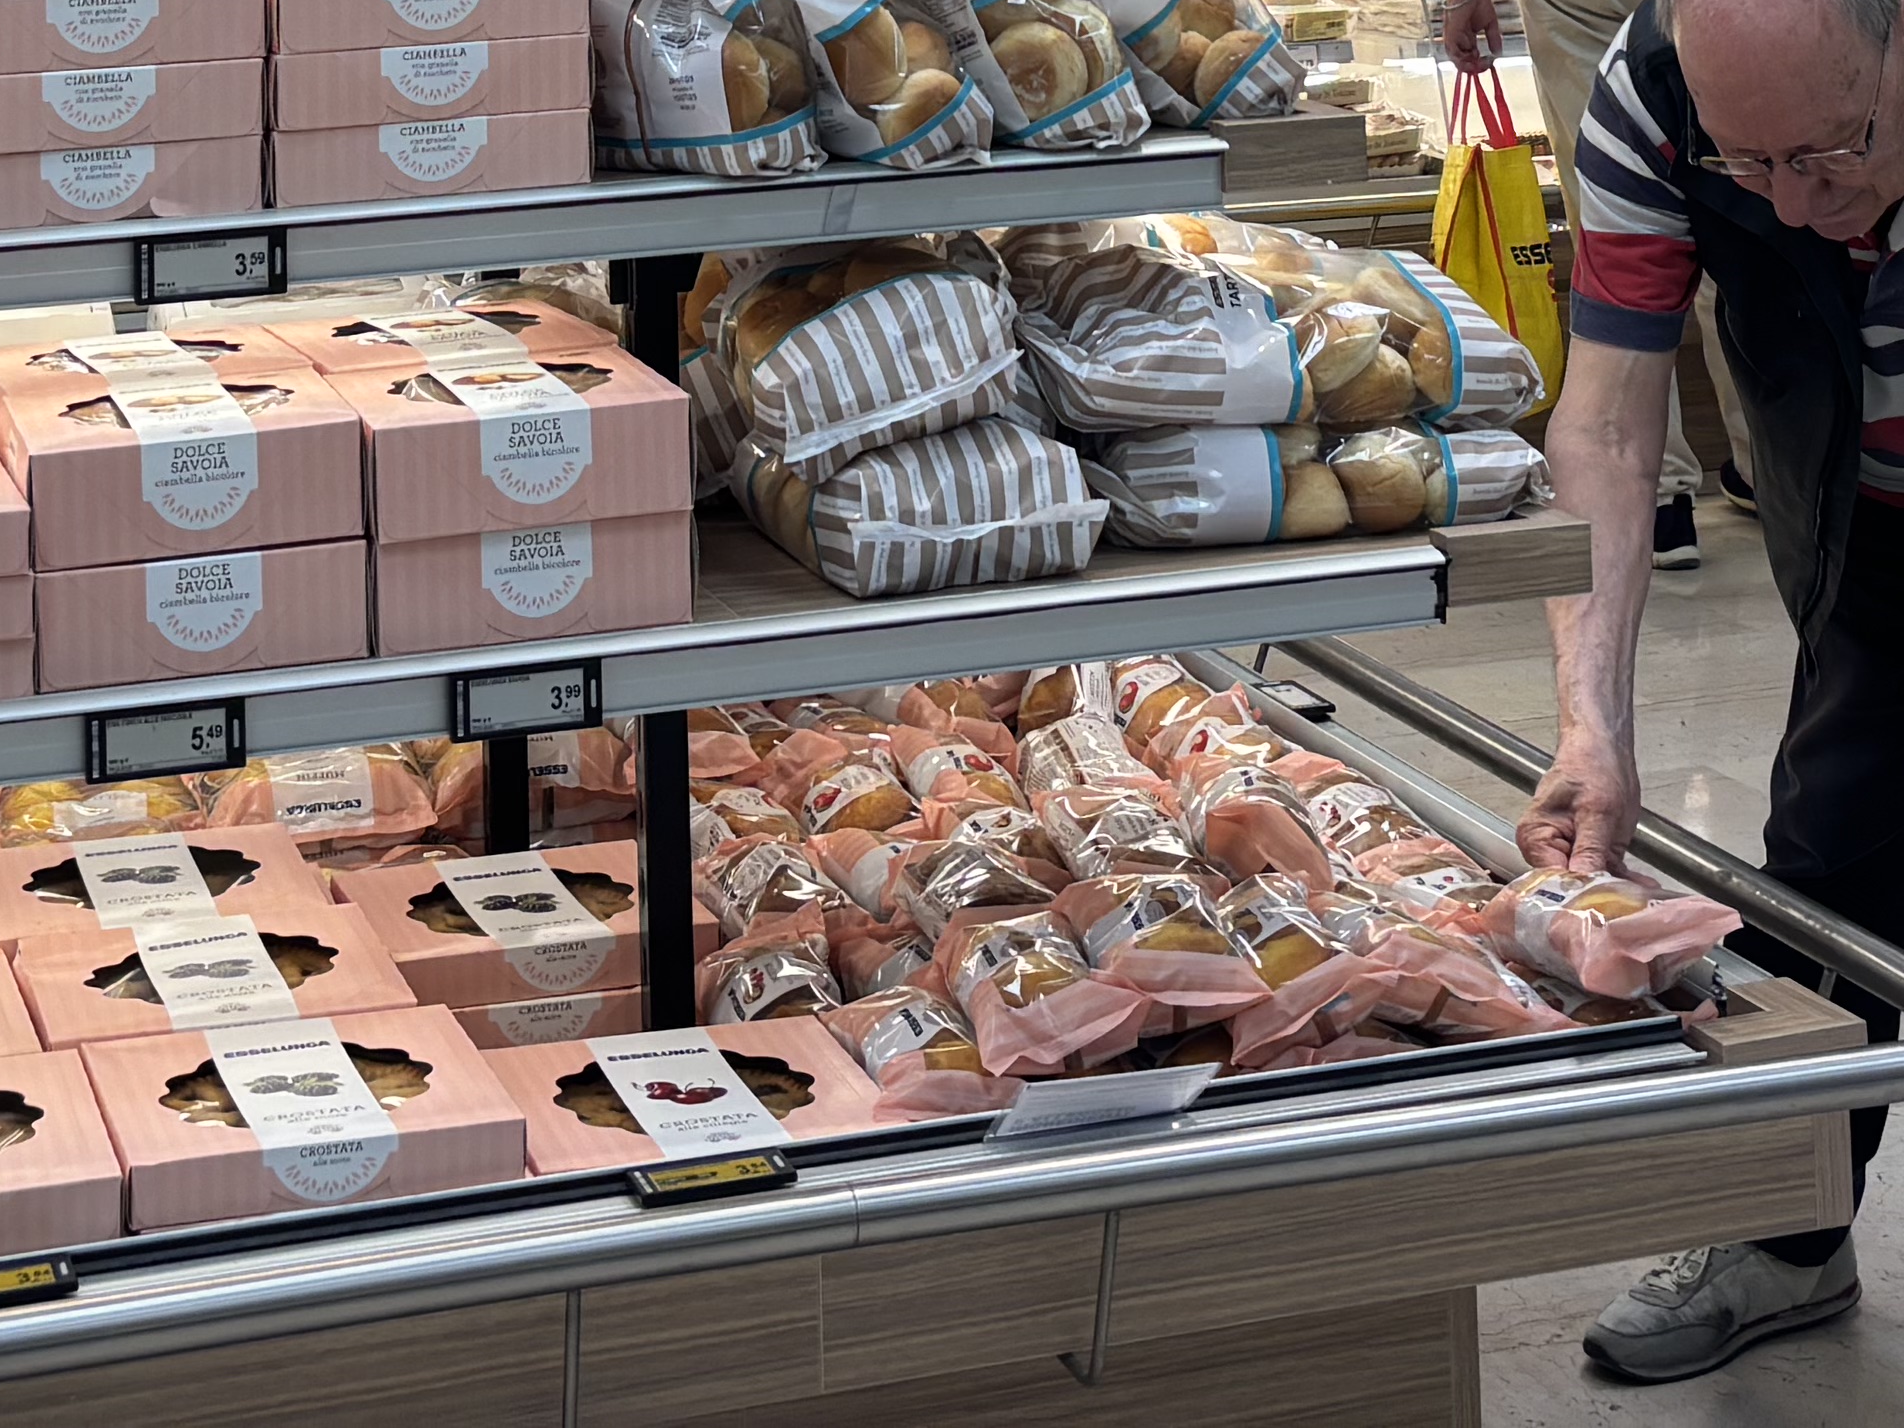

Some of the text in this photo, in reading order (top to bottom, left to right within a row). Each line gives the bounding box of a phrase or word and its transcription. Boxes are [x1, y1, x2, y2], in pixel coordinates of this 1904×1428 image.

[401, 47, 468, 62] CIAMBELLA
[63, 71, 134, 87] CIAMBELLA
[399, 122, 467, 137] CIAMBELLA
[62, 149, 132, 164] CIAMBELLA
[233, 251, 266, 275] 3,59
[510, 417, 562, 434] DOLCE
[508, 430, 565, 448] SAVOIA
[173, 442, 227, 460] DOLCE
[170, 454, 229, 474] SAVOIA
[510, 530, 562, 547] DOLCE
[508, 544, 565, 561] SAVOIA
[177, 563, 231, 580] DOLCE
[174, 576, 234, 595] SAVOIA
[550, 684, 581, 709] 3,99
[191, 725, 223, 750] 5,49
[534, 941, 588, 955] CROSTATA
[518, 1001, 573, 1015] CROSTATA
[659, 1112, 759, 1130] CROSTATA
[300, 1141, 364, 1160] CROSTATA
